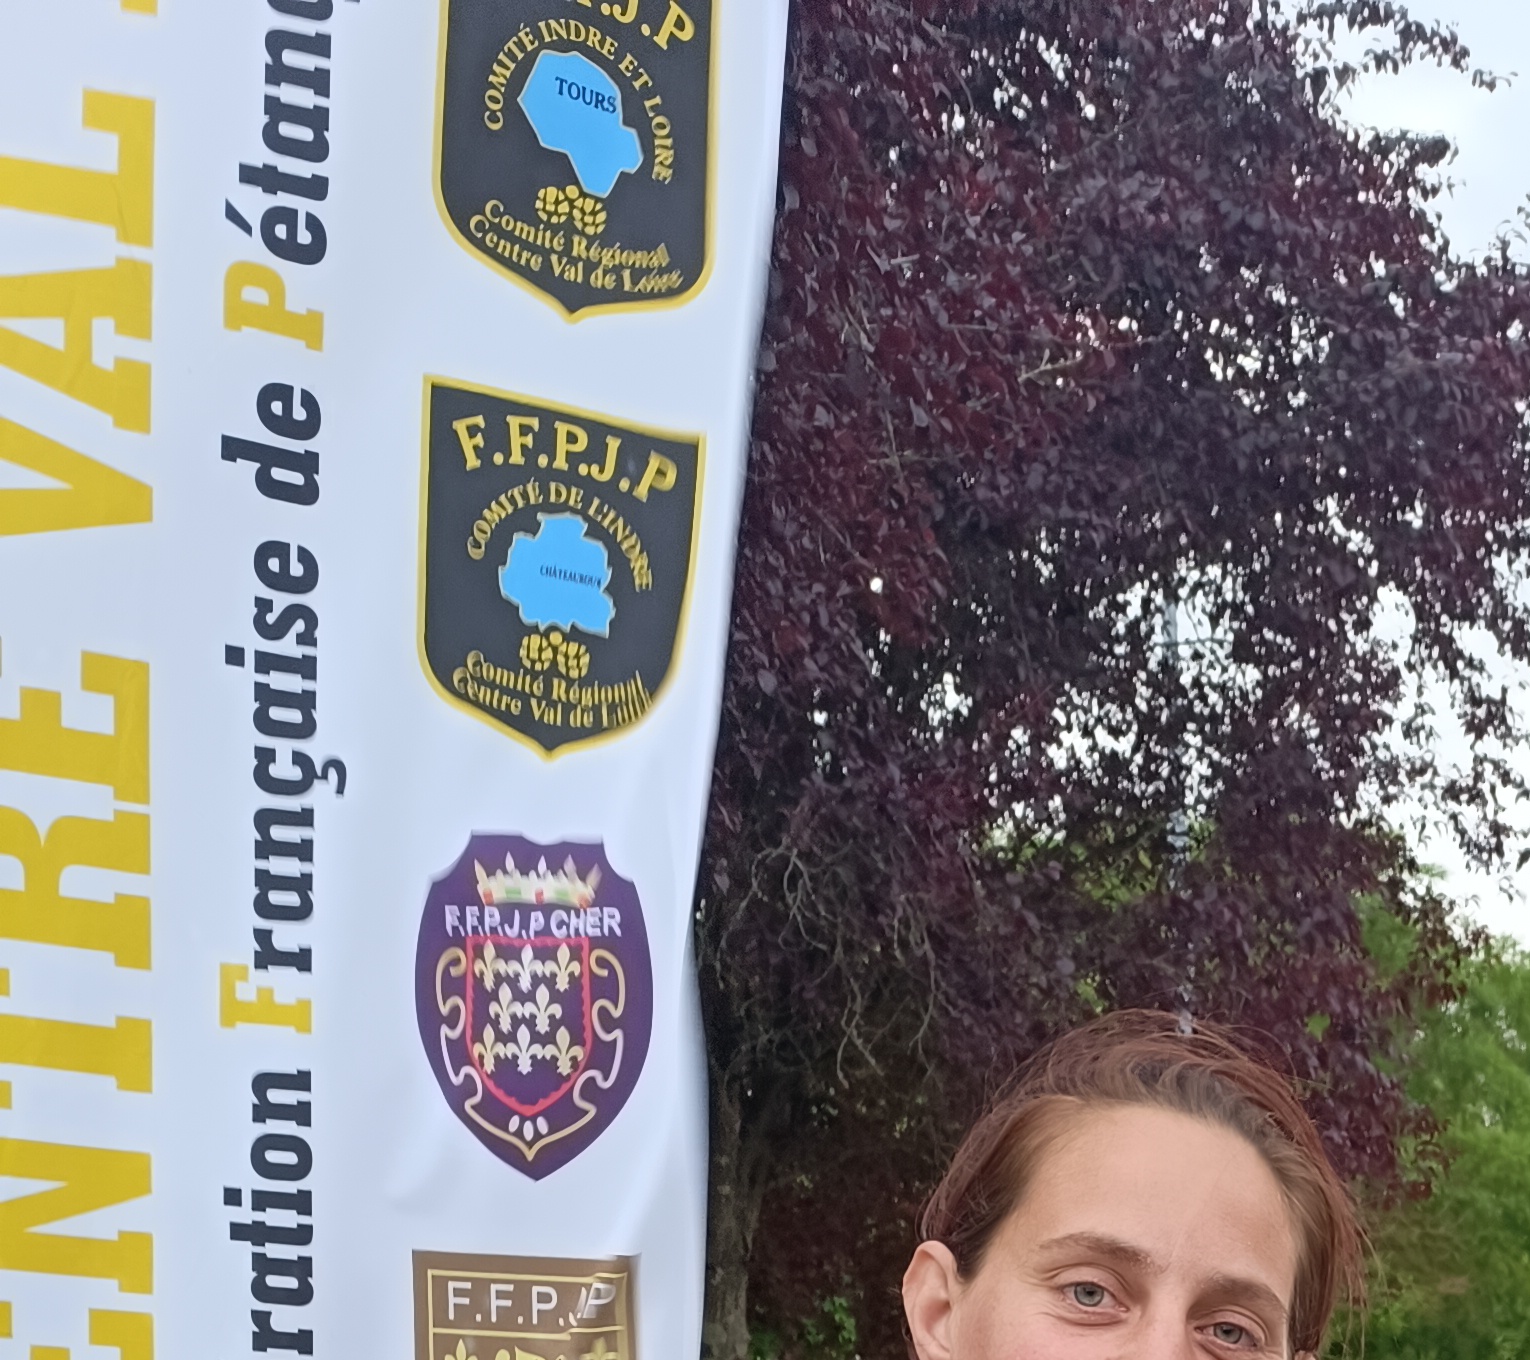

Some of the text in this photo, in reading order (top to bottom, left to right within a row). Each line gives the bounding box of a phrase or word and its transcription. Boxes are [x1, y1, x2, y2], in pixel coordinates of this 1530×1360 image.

[484, 19, 675, 185] COMITÉ INDRE ET LOIRE
[555, 76, 618, 114] TOURS
[469, 214, 542, 272] Centre
[550, 253, 584, 283] Val
[590, 265, 616, 290] de
[484, 200, 565, 251] Comité
[0, 87, 155, 535] VAL
[221, 381, 322, 506] de
[452, 414, 678, 503] F.F.P.J.P
[467, 477, 543, 561] COMITÉ
[550, 481, 584, 510] DE
[453, 667, 522, 716] Centre
[530, 697, 562, 728] Val
[466, 650, 544, 697] Comité
[219, 539, 347, 1035] Française
[550, 906, 622, 939] CHER
